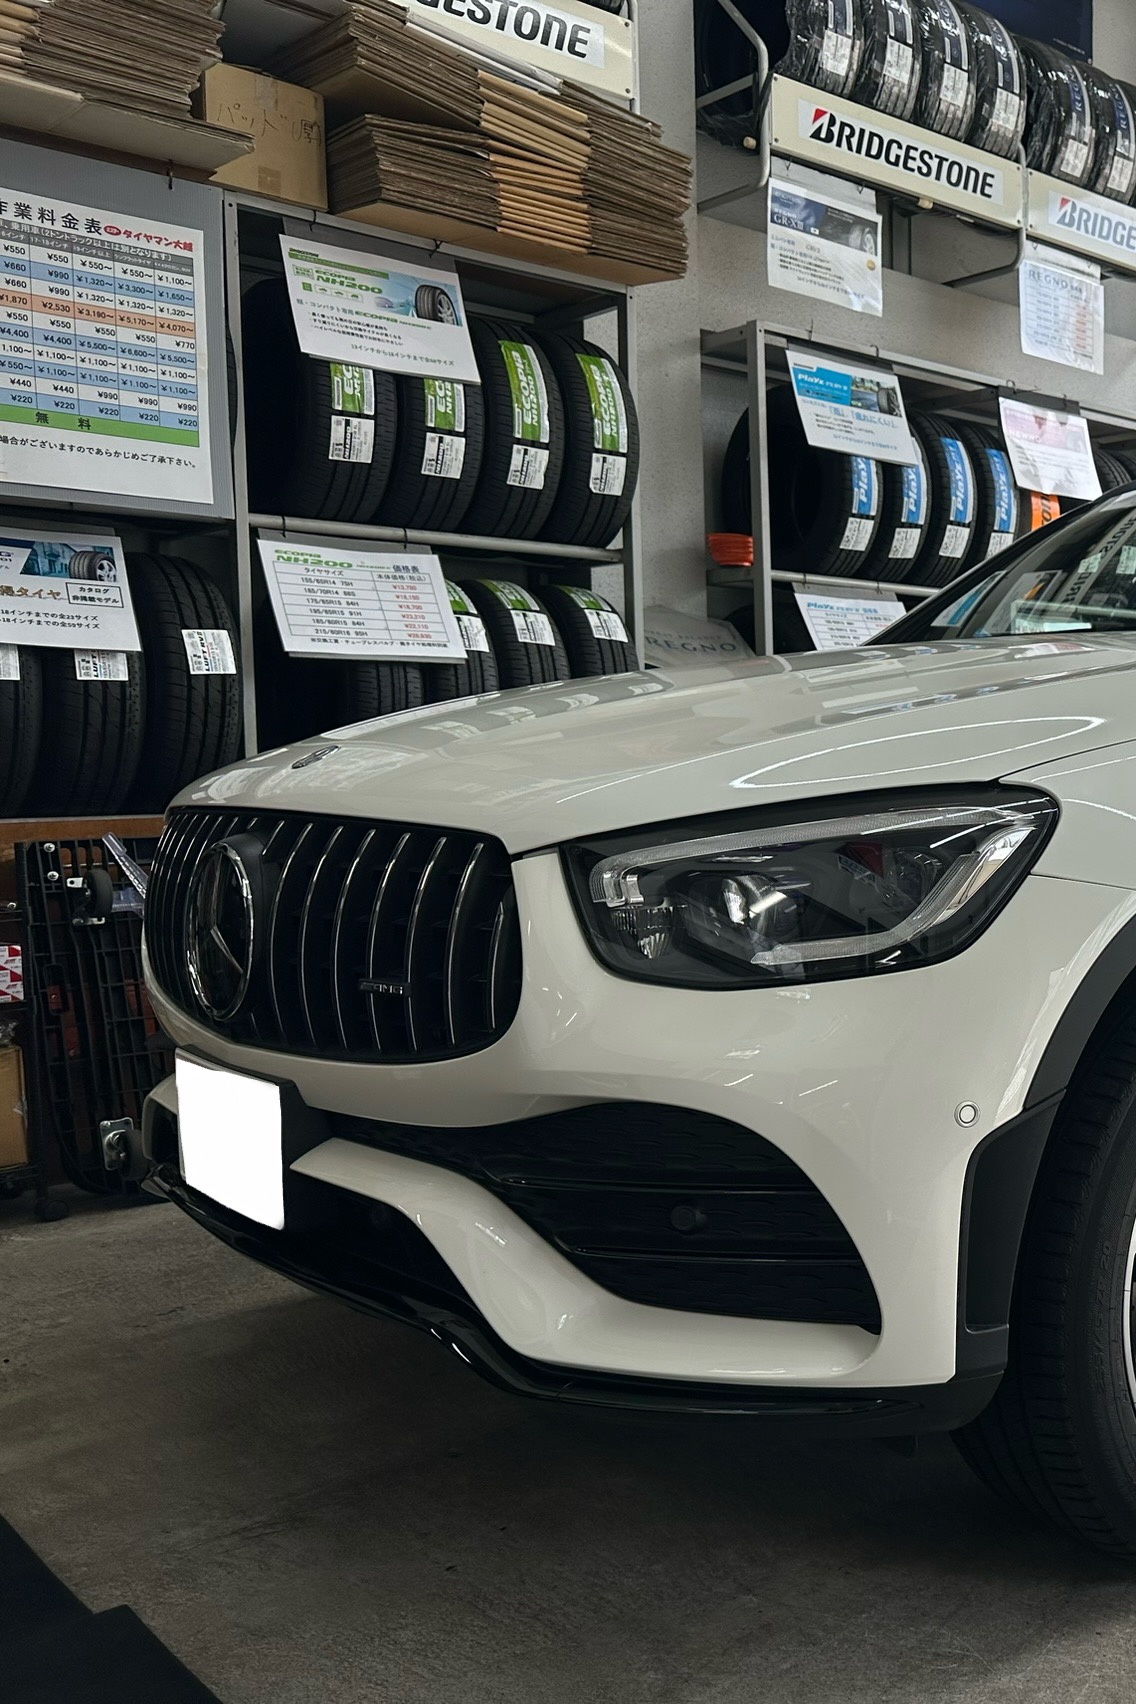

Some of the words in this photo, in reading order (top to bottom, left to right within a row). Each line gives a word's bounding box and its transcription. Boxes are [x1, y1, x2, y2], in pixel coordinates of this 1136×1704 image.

[416, 0, 591, 58] ESTONE
[809, 108, 995, 199] BRIDGESTONE
[3, 243, 26, 255] ¥550
[47, 252, 69, 264] ¥550
[4, 260, 26, 272] ¥660
[48, 269, 69, 280] ¥990
[5, 277, 27, 289] ¥660
[48, 285, 70, 297] ¥990
[316, 275, 383, 295] NH200
[0, 293, 28, 305] ¥1,870
[42, 301, 70, 313] ¥2,530
[0, 326, 29, 338] ¥4,400
[43, 334, 72, 345] ¥4,400
[6, 311, 28, 322] ¥550
[49, 318, 71, 329] ¥550
[94, 326, 116, 337] ¥550
[135, 333, 156, 343] ¥550
[175, 340, 195, 350] ¥770
[9, 377, 32, 388] ¥440
[52, 384, 74, 394] ¥440
[97, 390, 118, 400] ¥990
[137, 396, 158, 406] ¥990
[177, 402, 197, 412] ¥990
[511, 350, 532, 425] ECOPIA
[10, 393, 33, 404] ¥220
[53, 400, 75, 410] ¥220
[98, 406, 119, 416] ¥220
[138, 412, 159, 422] ¥220
[177, 418, 197, 428] ¥220
[527, 375, 539, 426] NH200
[857, 457, 868, 503] Play
[276, 555, 353, 568] NH200
[304, 567, 344, 577] タイヤサイズ
[79, 586, 110, 594] カタログ
[201, 649, 210, 672] LUFT
